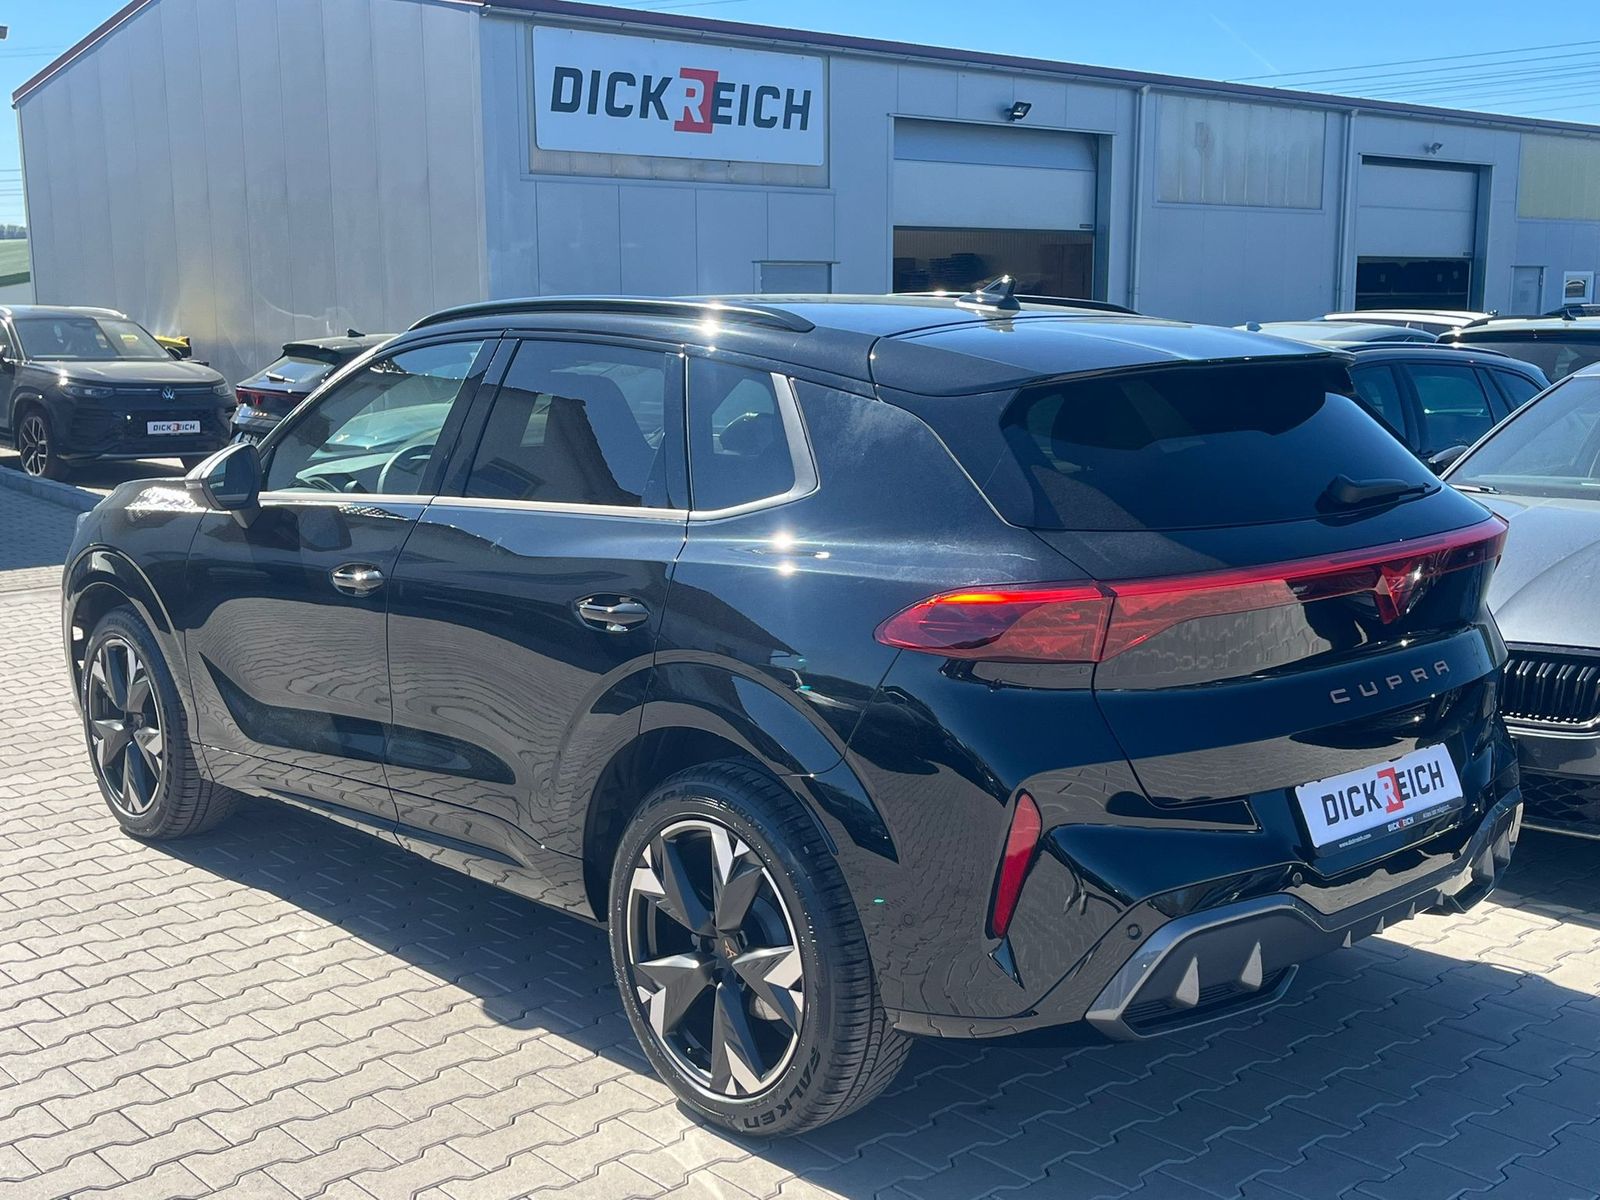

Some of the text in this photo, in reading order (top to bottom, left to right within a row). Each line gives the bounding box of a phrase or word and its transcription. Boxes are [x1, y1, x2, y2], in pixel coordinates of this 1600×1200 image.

[551, 66, 811, 134] DICKREICH
[1330, 660, 1450, 704] CUPRA
[1321, 760, 1445, 826] DICKREICH
[743, 1045, 821, 1129] FALKEN
